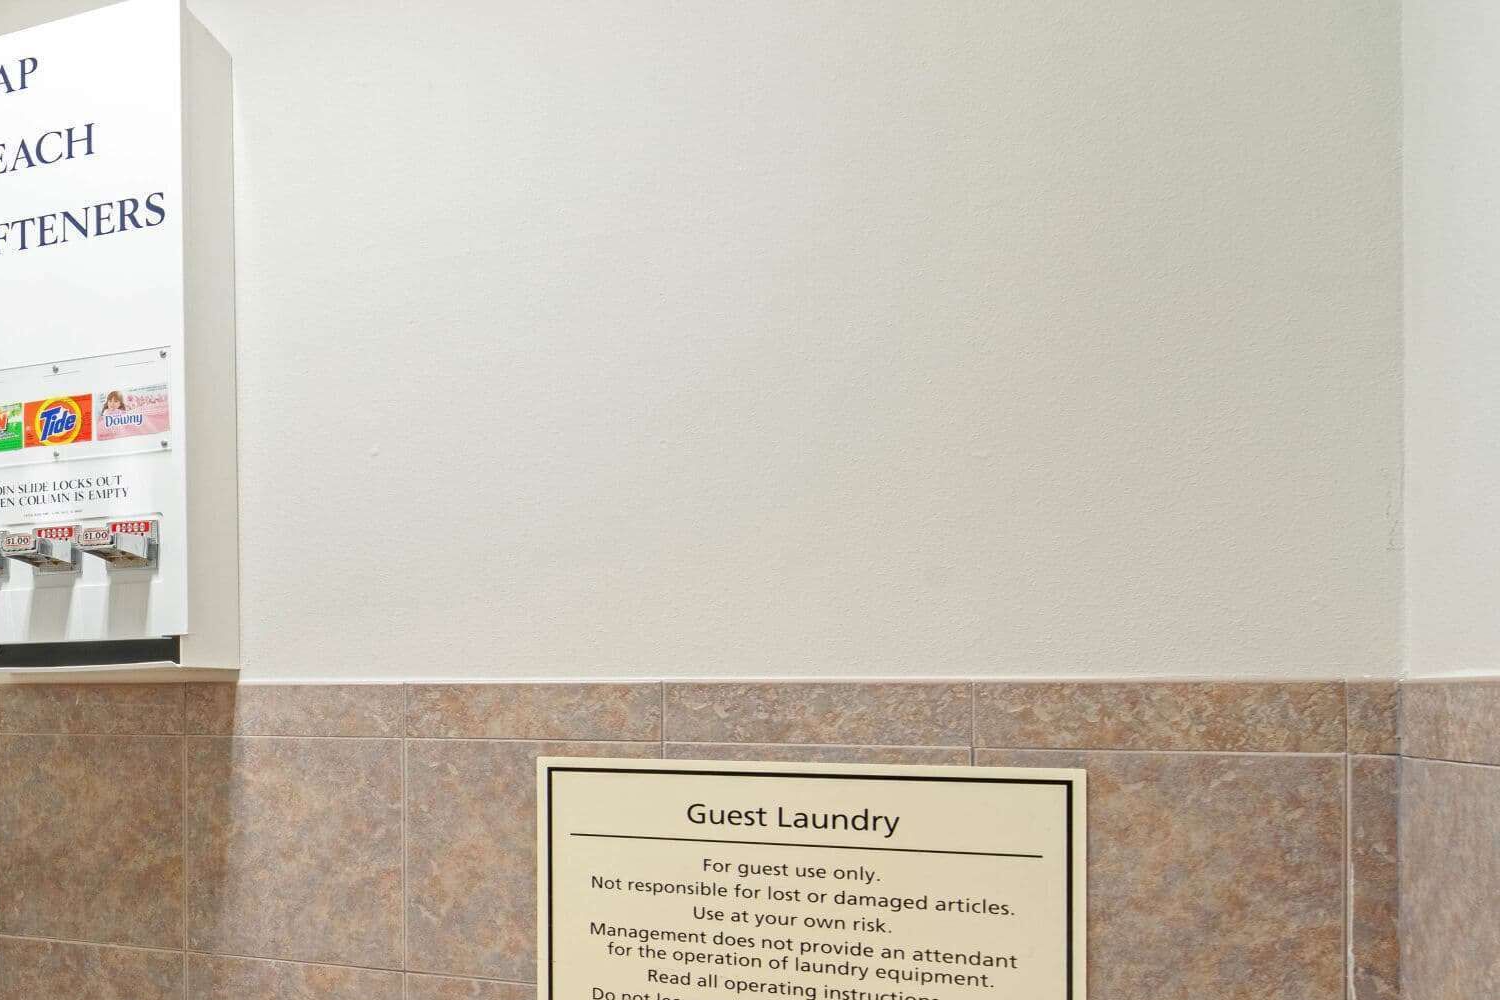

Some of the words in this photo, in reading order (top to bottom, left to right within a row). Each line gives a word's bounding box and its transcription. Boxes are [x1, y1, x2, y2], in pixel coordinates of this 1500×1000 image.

[40, 406, 77, 441] Tide
[105, 414, 143, 428] Downy
[18, 482, 48, 495] SLIDE
[53, 477, 92, 492] LOCKS
[96, 474, 123, 487] OUT
[19, 493, 70, 506] COLUMN
[75, 491, 84, 501] IS
[88, 487, 128, 500] EMPTY
[6, 536, 29, 545] $1.00
[83, 530, 108, 540] $1.00
[687, 803, 768, 827] Guest
[778, 806, 900, 839] Laundry
[703, 858, 732, 873] For
[738, 863, 789, 878] guest
[796, 867, 827, 879] use
[833, 866, 880, 885] only.
[591, 875, 622, 890] Not
[628, 881, 728, 897] responsible
[733, 884, 761, 899] for
[768, 886, 801, 902] lost
[807, 892, 828, 904] or
[834, 890, 927, 912] damaged
[935, 898, 1015, 916] articles.
[693, 906, 725, 921] Use
[730, 910, 749, 923] at
[754, 914, 798, 928] your
[804, 917, 845, 930] own
[853, 917, 892, 933] risk.
[590, 922, 707, 944] Management
[713, 931, 755, 948] does
[761, 938, 794, 952] not
[800, 941, 874, 958] provide
[881, 948, 905, 960] an
[912, 949, 1018, 970] attendant
[607, 941, 633, 956] for
[637, 944, 667, 960] the
[672, 950, 762, 968] operation
[768, 956, 789, 970] of
[795, 957, 869, 981] laundry
[875, 967, 994, 988] equipment.
[648, 969, 691, 986] Read
[697, 974, 717, 988] all
[724, 979, 816, 1000] operating
